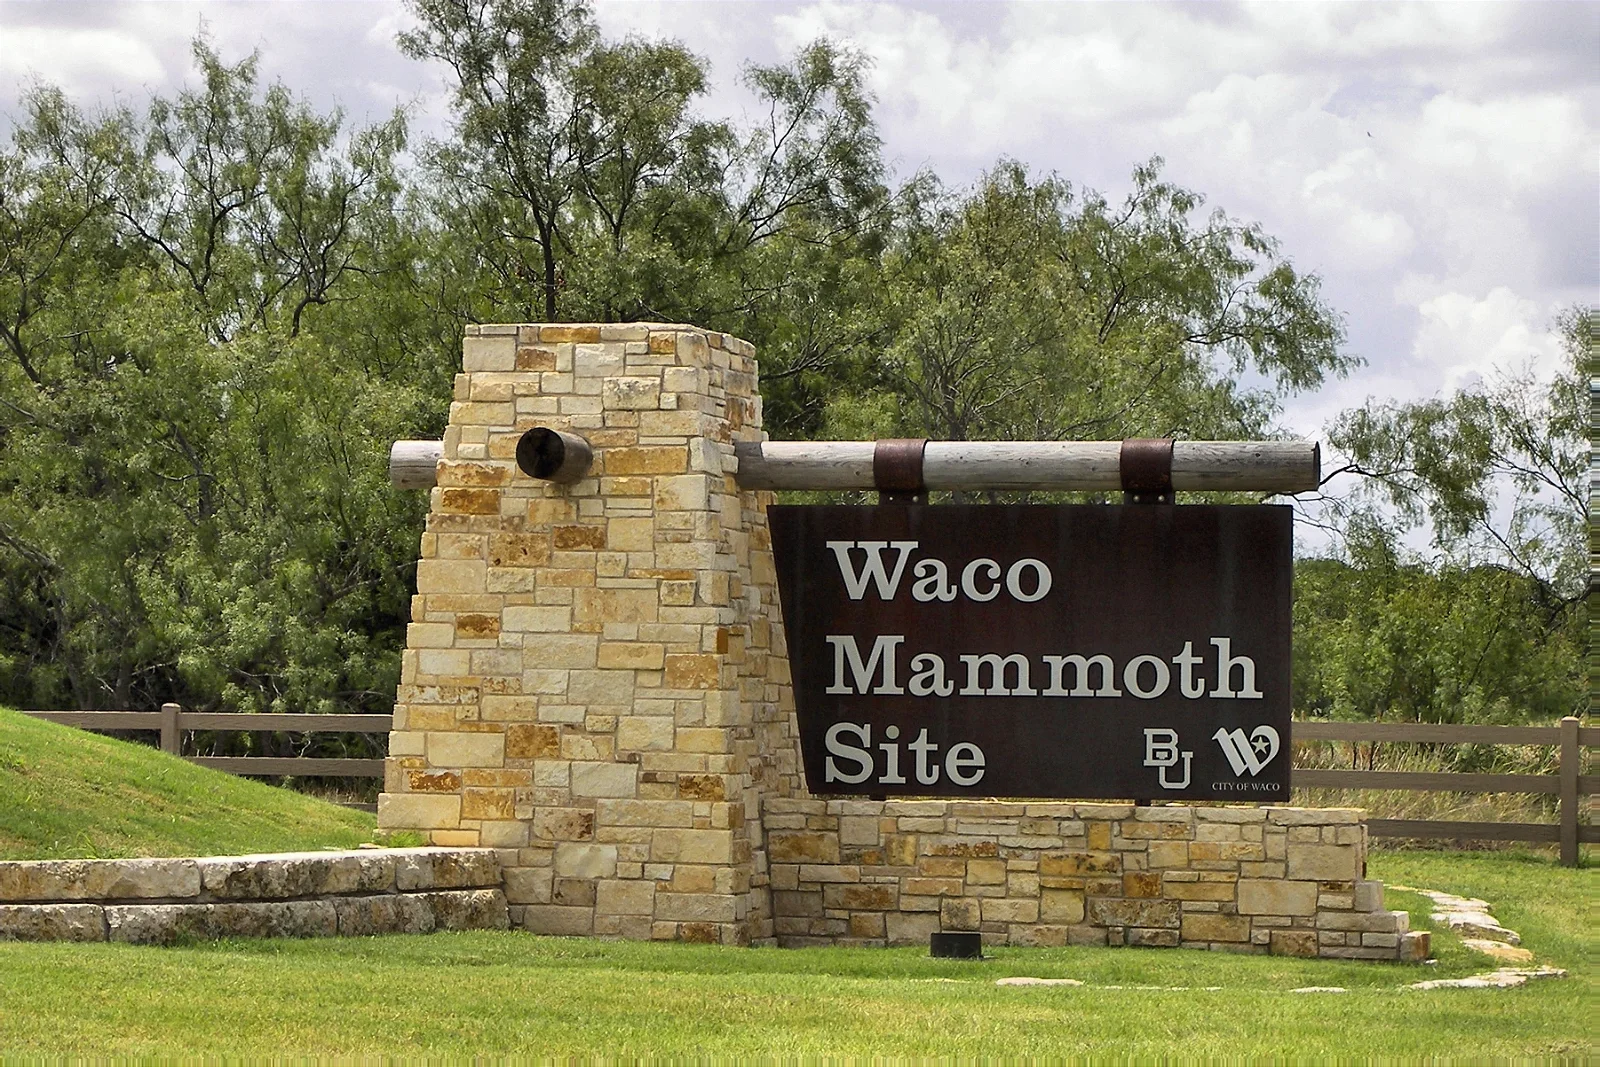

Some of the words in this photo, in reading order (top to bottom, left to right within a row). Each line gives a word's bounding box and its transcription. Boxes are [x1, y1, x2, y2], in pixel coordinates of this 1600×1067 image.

[826, 540, 1052, 602] Waco
[825, 635, 1264, 699] Mammoth
[825, 722, 986, 785] Site
[1143, 728, 1194, 790] BU
[1211, 782, 1234, 791] CITY
[1236, 782, 1249, 791] OF
[1250, 782, 1280, 791] WACO
